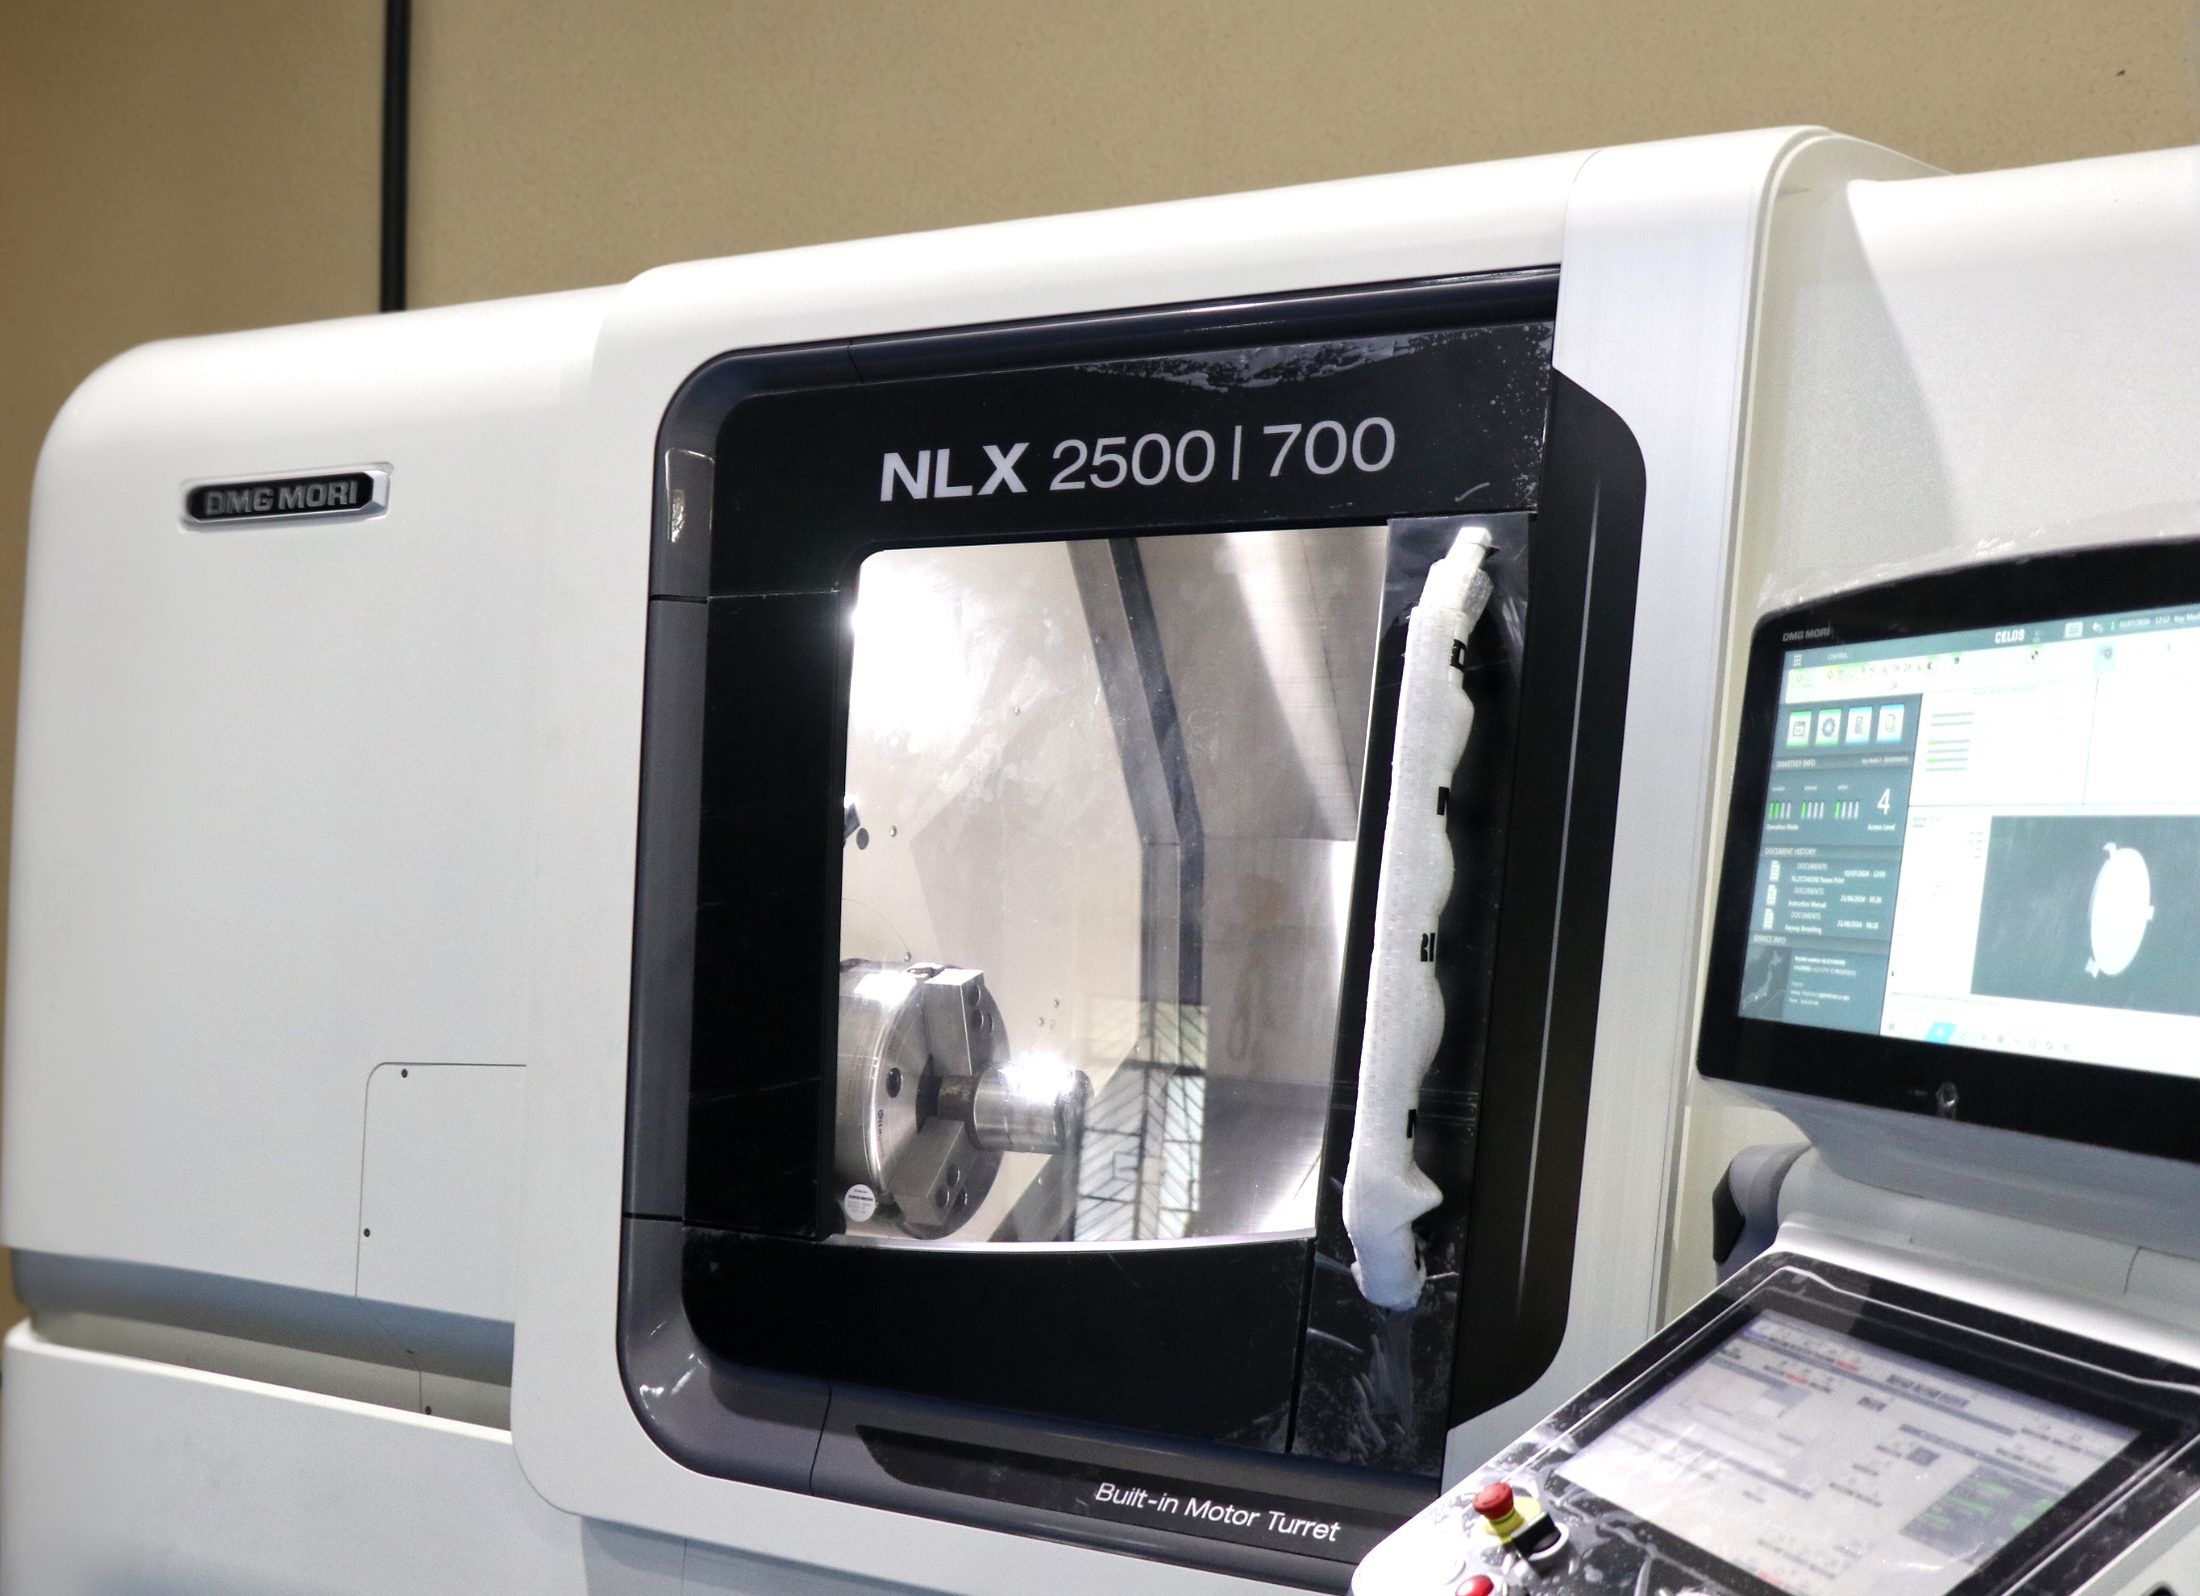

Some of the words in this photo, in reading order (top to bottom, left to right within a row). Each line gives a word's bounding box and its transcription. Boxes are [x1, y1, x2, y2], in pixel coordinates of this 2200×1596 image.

[880, 442, 1029, 502] NLX
[1049, 430, 1216, 491] 2500
[1263, 416, 1396, 478] 700
[206, 487, 273, 515] DMG
[278, 480, 358, 510] MORI
[1782, 629, 1804, 642] DMG
[1805, 627, 1831, 639] MORI
[1994, 628, 2026, 644] CELOS
[1877, 788, 1890, 815] 4
[1095, 1482, 1179, 1514] Built-in
[1184, 1497, 1260, 1527] Motor
[1268, 1510, 1341, 1542] Turret
